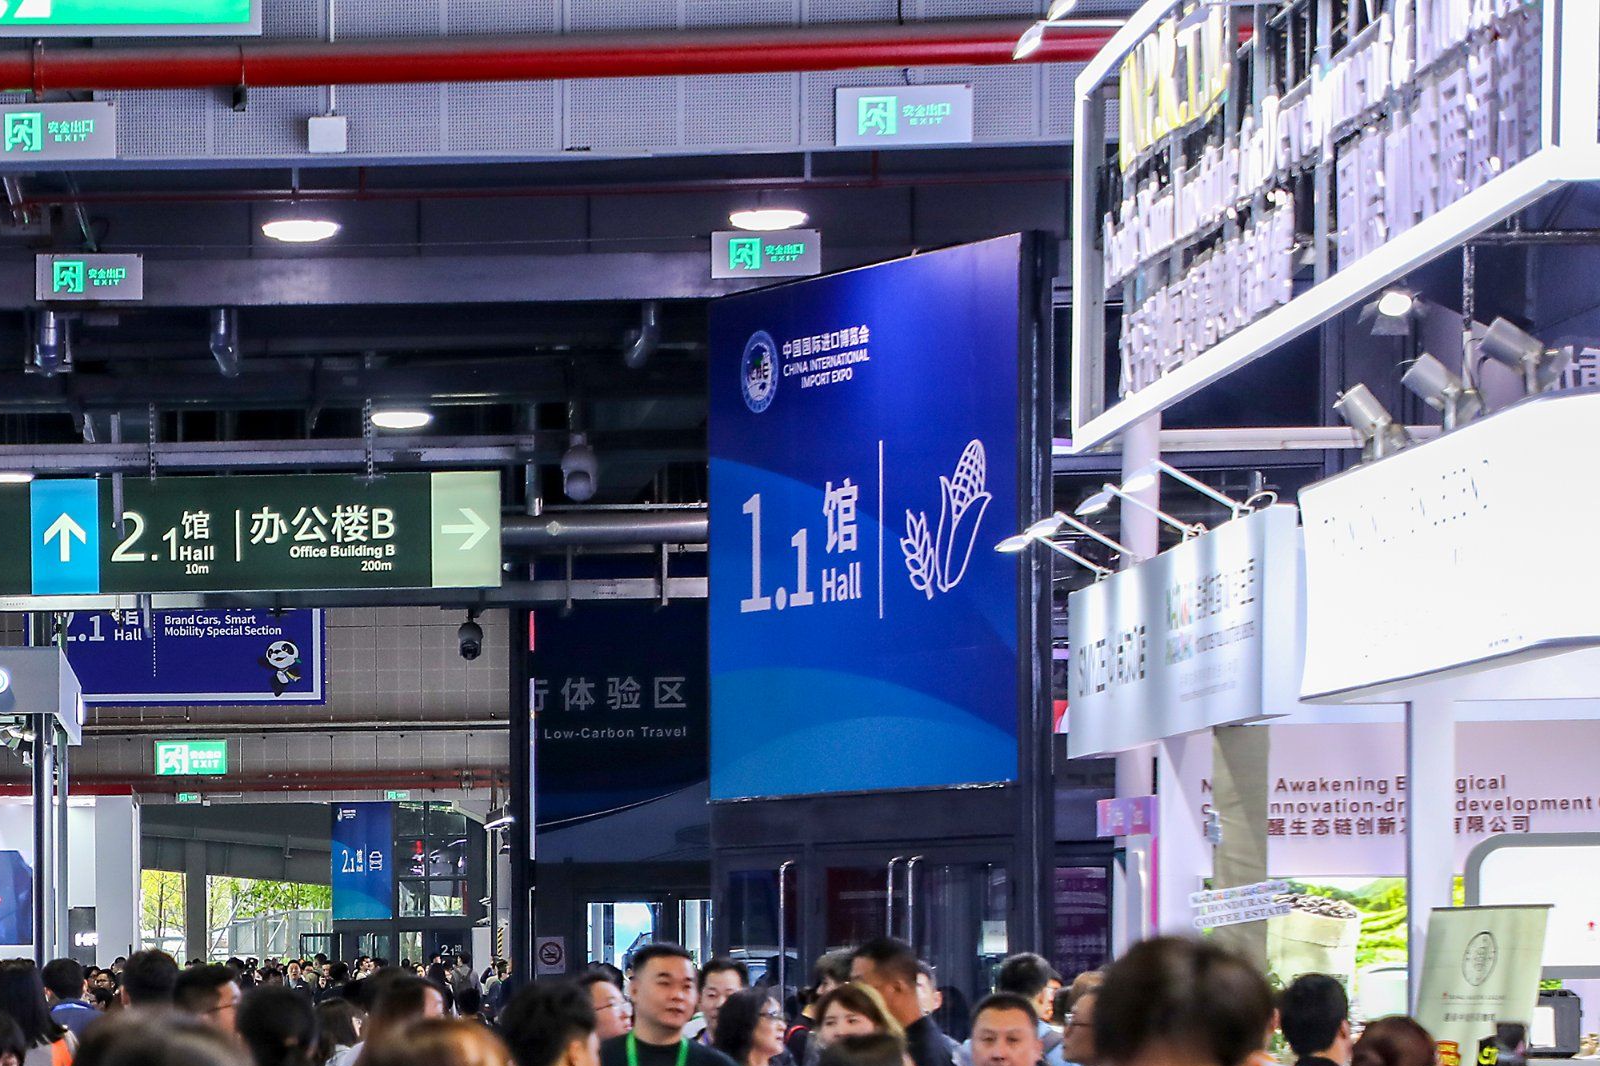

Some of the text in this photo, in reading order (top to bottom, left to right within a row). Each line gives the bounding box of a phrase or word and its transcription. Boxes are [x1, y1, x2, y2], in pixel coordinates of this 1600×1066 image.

[903, 103, 950, 117] 安全出口
[47, 120, 94, 133] 安全出口
[765, 244, 805, 255] 安全出口
[88, 268, 126, 279] 安全出口
[782, 324, 870, 359] 中国国际进口博览会
[783, 348, 871, 377] CHINA INTERNATIONAL
[801, 367, 853, 389] IMPORT EXPO
[250, 504, 396, 544] 办公楼B
[111, 510, 210, 562] 2.1 馆
[289, 544, 396, 558] Office Building B
[740, 477, 858, 613] 1.1 馆
[179, 546, 215, 561] Hall
[185, 564, 209, 575] 10m
[361, 560, 392, 571] 200m
[822, 562, 861, 602] Hall
[164, 614, 257, 627] Brand Cars, Smart
[114, 628, 142, 641] Hall
[164, 625, 282, 638] Mobility Special Section
[544, 726, 687, 740] Low-Carbon Travel
[193, 760, 219, 768] EXIT
[1274, 776, 1388, 795] Awakening
[1455, 796, 1593, 815] development
[1194, 904, 1291, 927] COFFEE ESTATE
